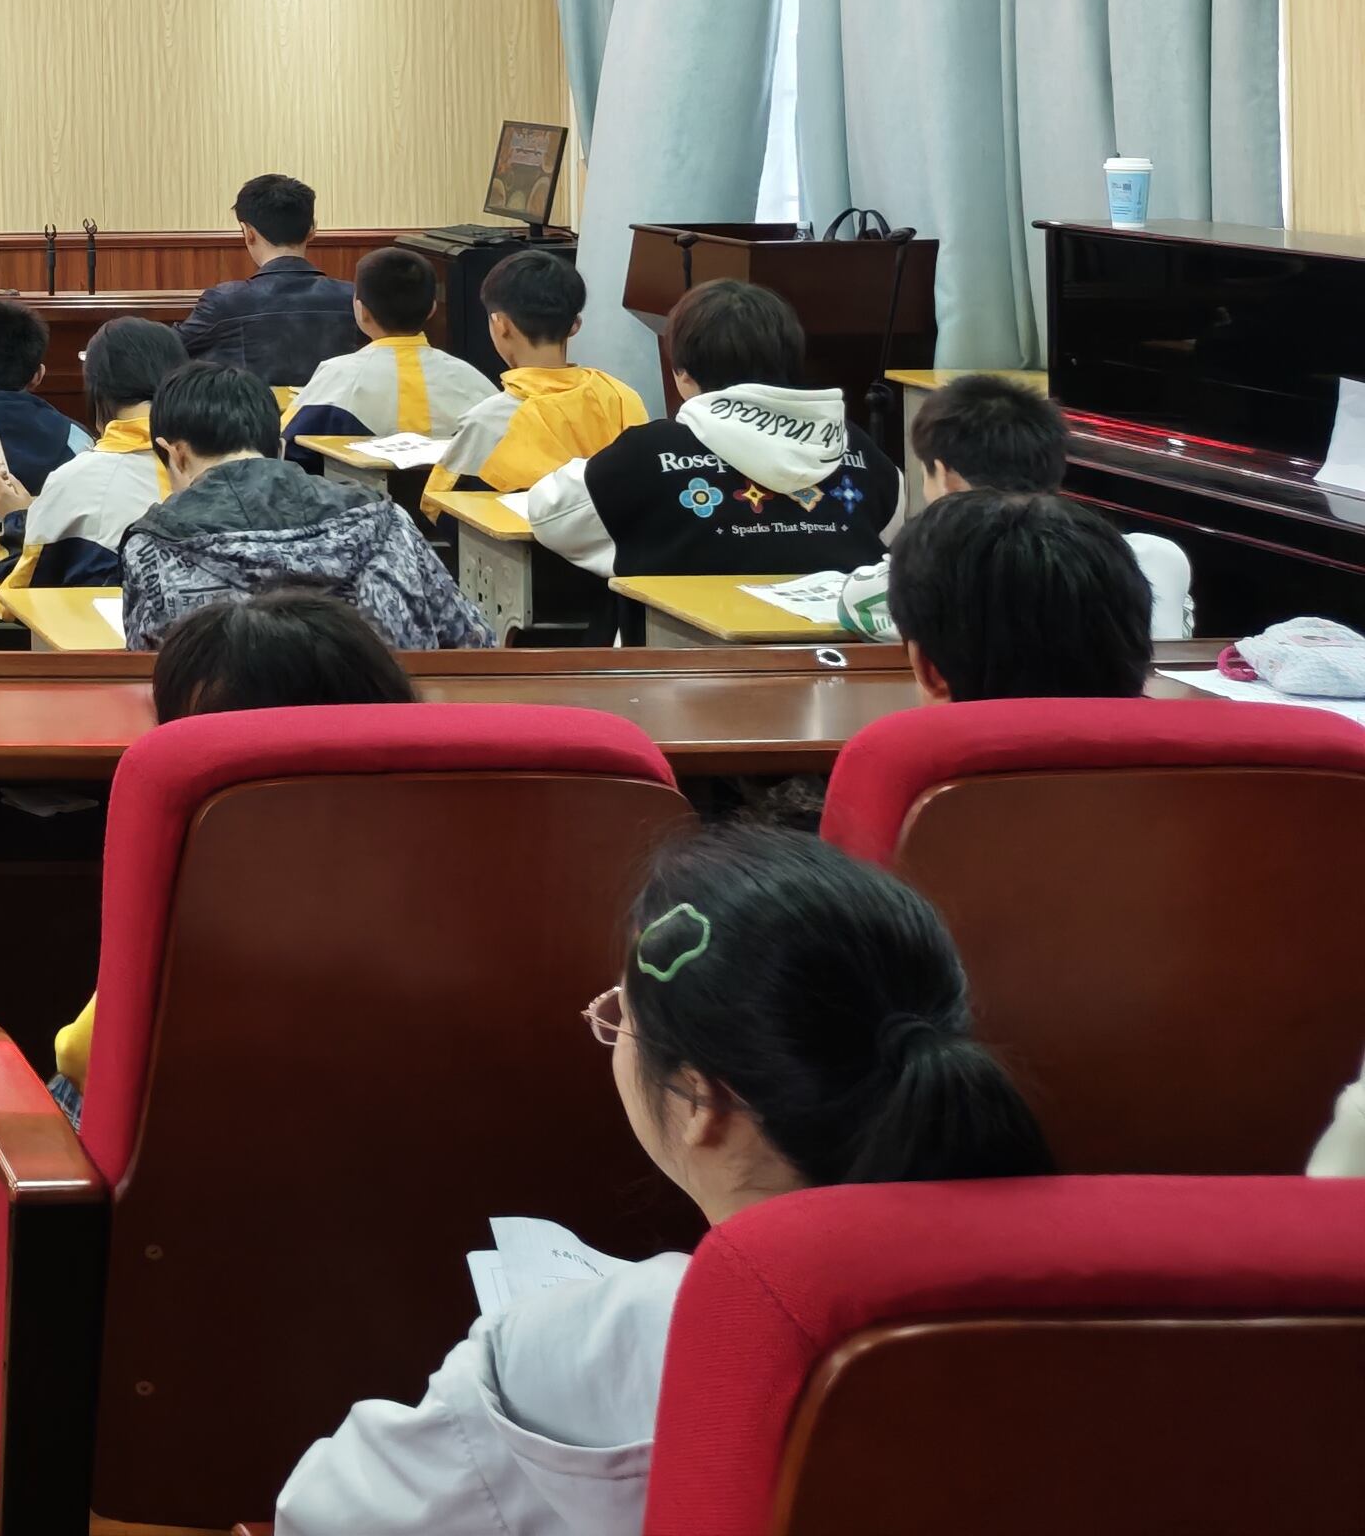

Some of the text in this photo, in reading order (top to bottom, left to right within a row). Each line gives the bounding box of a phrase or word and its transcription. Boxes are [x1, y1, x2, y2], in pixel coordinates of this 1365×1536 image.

[731, 520, 836, 537] Sparks That Spread
